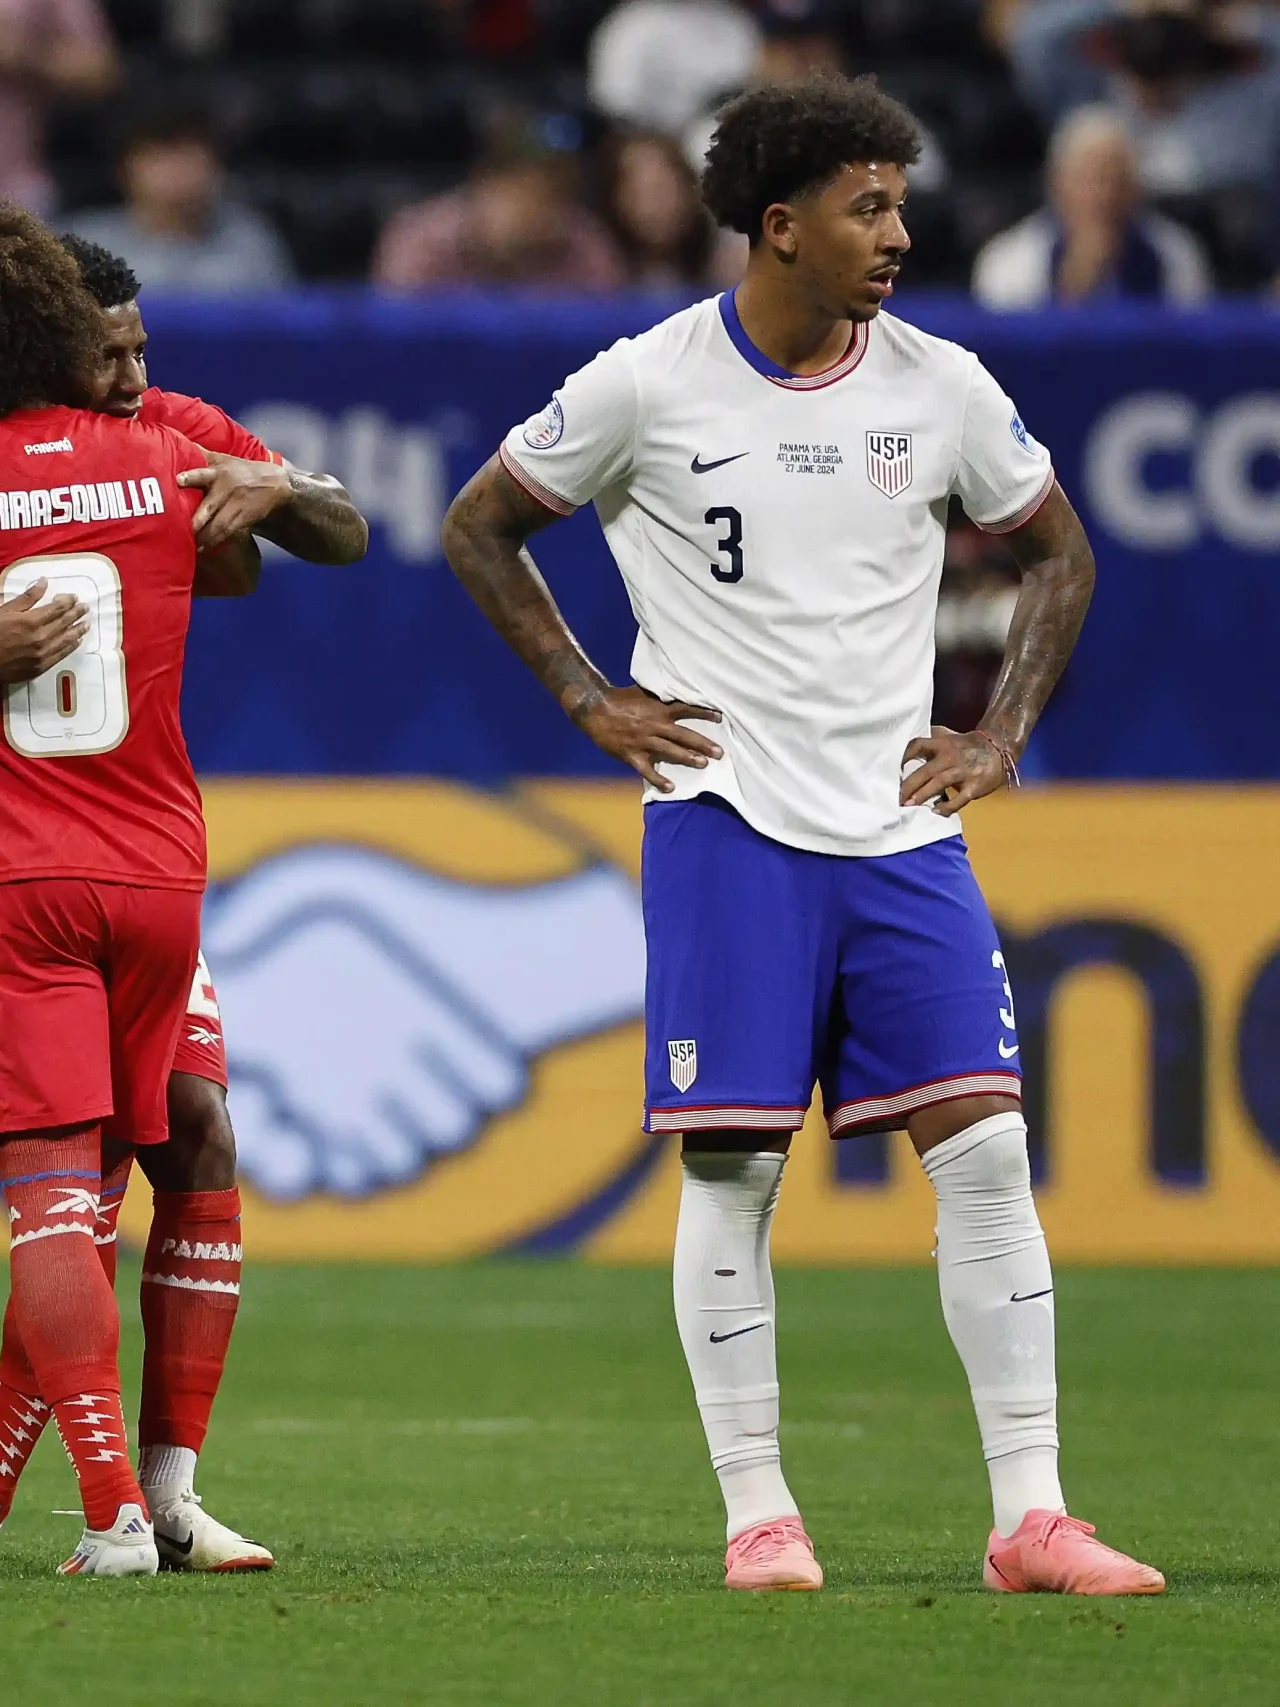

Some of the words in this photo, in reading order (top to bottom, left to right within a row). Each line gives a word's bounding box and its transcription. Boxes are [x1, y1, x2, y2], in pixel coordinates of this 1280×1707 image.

[779, 443, 809, 454] PANAMA
[812, 445, 822, 454] VS.
[824, 445, 839, 454] USA
[870, 435, 908, 461] USA
[813, 455, 843, 464] GEORGIA
[785, 463, 794, 473] 27
[797, 464, 815, 474] JUNE
[816, 465, 835, 474] 2024
[704, 506, 744, 584] 3
[670, 1042, 695, 1062] USA
